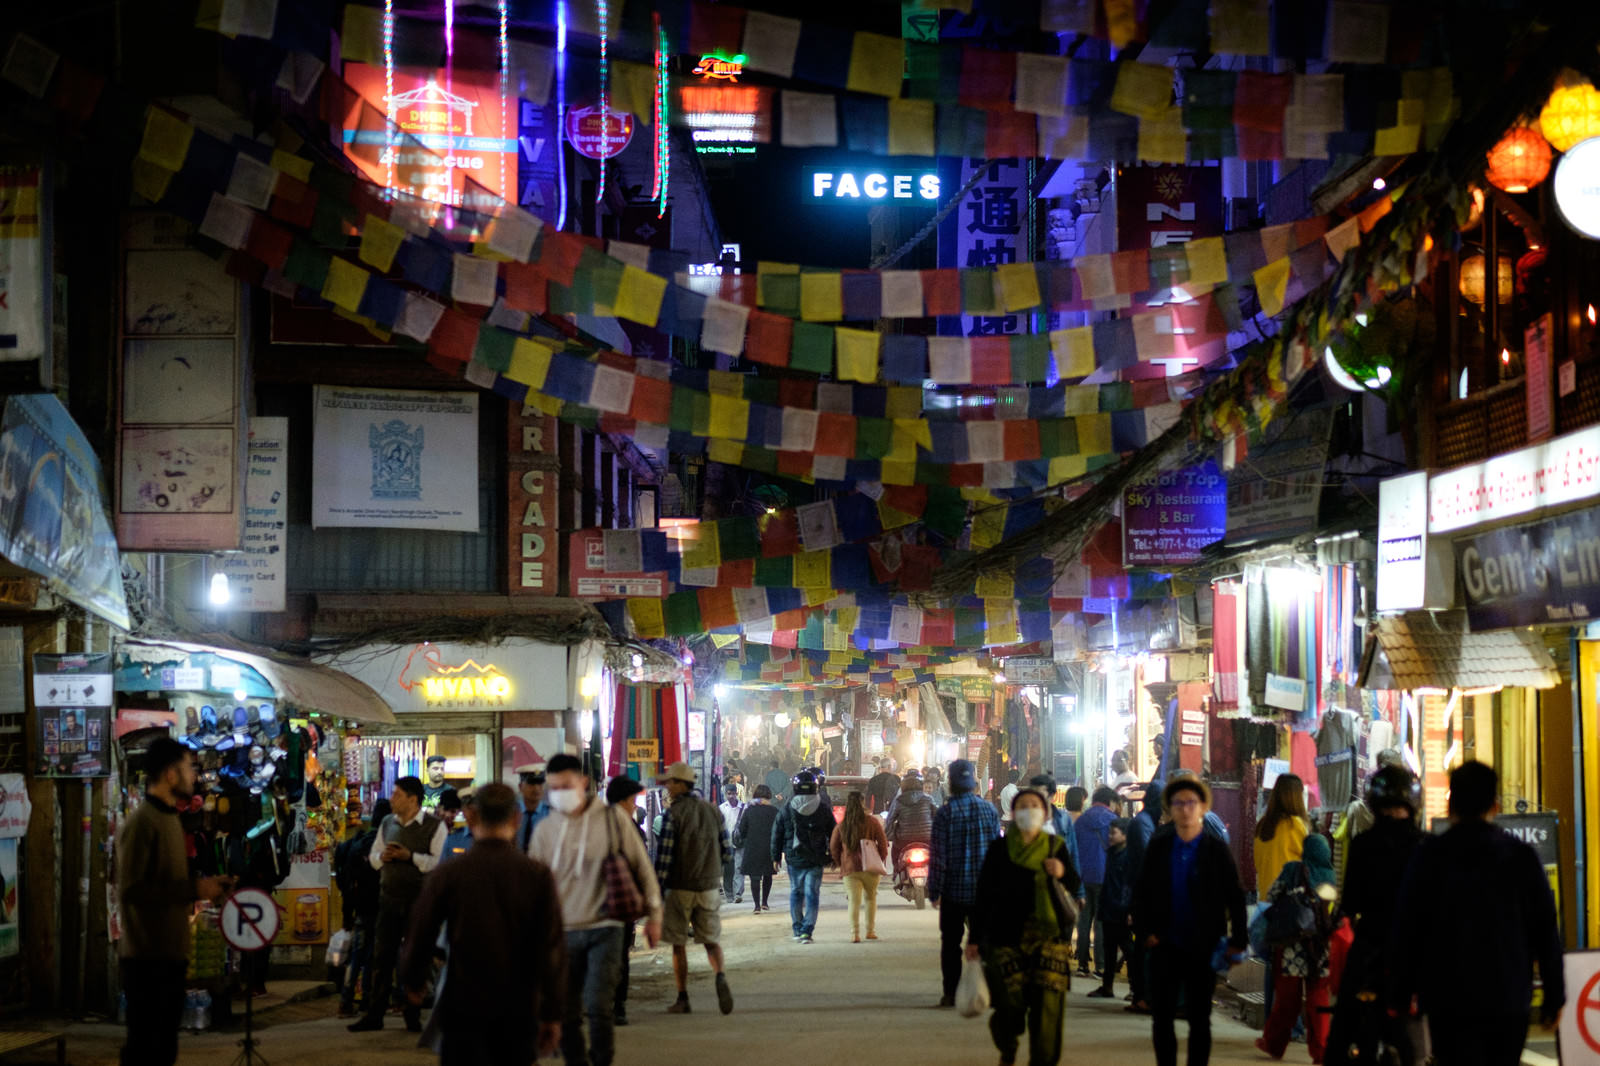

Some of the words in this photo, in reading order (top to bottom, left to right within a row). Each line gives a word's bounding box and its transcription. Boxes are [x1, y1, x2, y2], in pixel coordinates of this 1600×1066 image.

[813, 173, 941, 199] FACES
[1184, 472, 1219, 488] Top
[521, 402, 545, 587] ARCADE
[1128, 494, 1152, 508] Sky
[1156, 493, 1226, 505] Restaurant
[1160, 512, 1169, 523] &
[1173, 511, 1195, 523] Bar
[1463, 534, 1549, 599] Gem's
[425, 678, 511, 697] NYANO
[426, 696, 504, 707] PASHMINA
[238, 903, 263, 936] P
